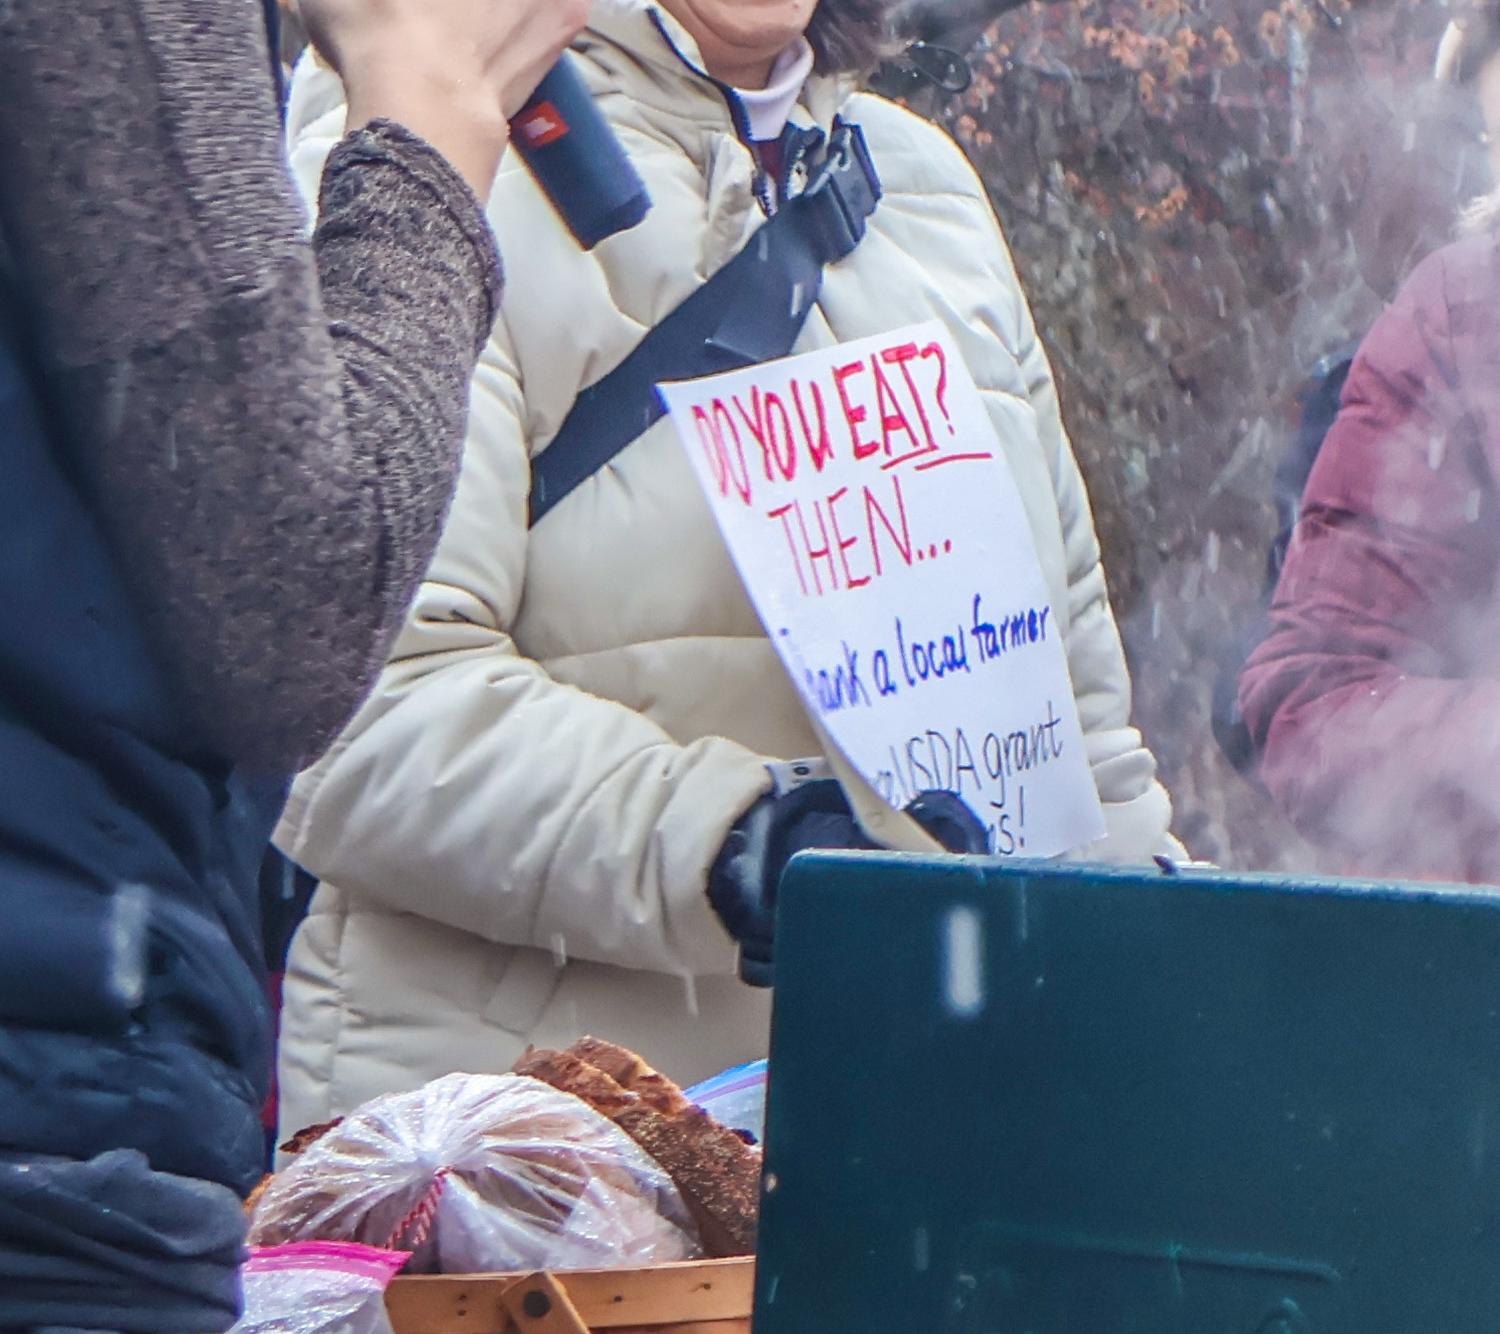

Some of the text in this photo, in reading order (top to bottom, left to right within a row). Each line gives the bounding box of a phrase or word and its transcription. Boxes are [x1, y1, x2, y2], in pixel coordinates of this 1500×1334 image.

[692, 342, 955, 506] DO YOU EAT?
[768, 475, 952, 597] THEN...
[803, 595, 1051, 713] ank a local farmer
[889, 728, 983, 803] USDA
[983, 700, 1064, 809] grant
[990, 785, 1025, 855] s!
